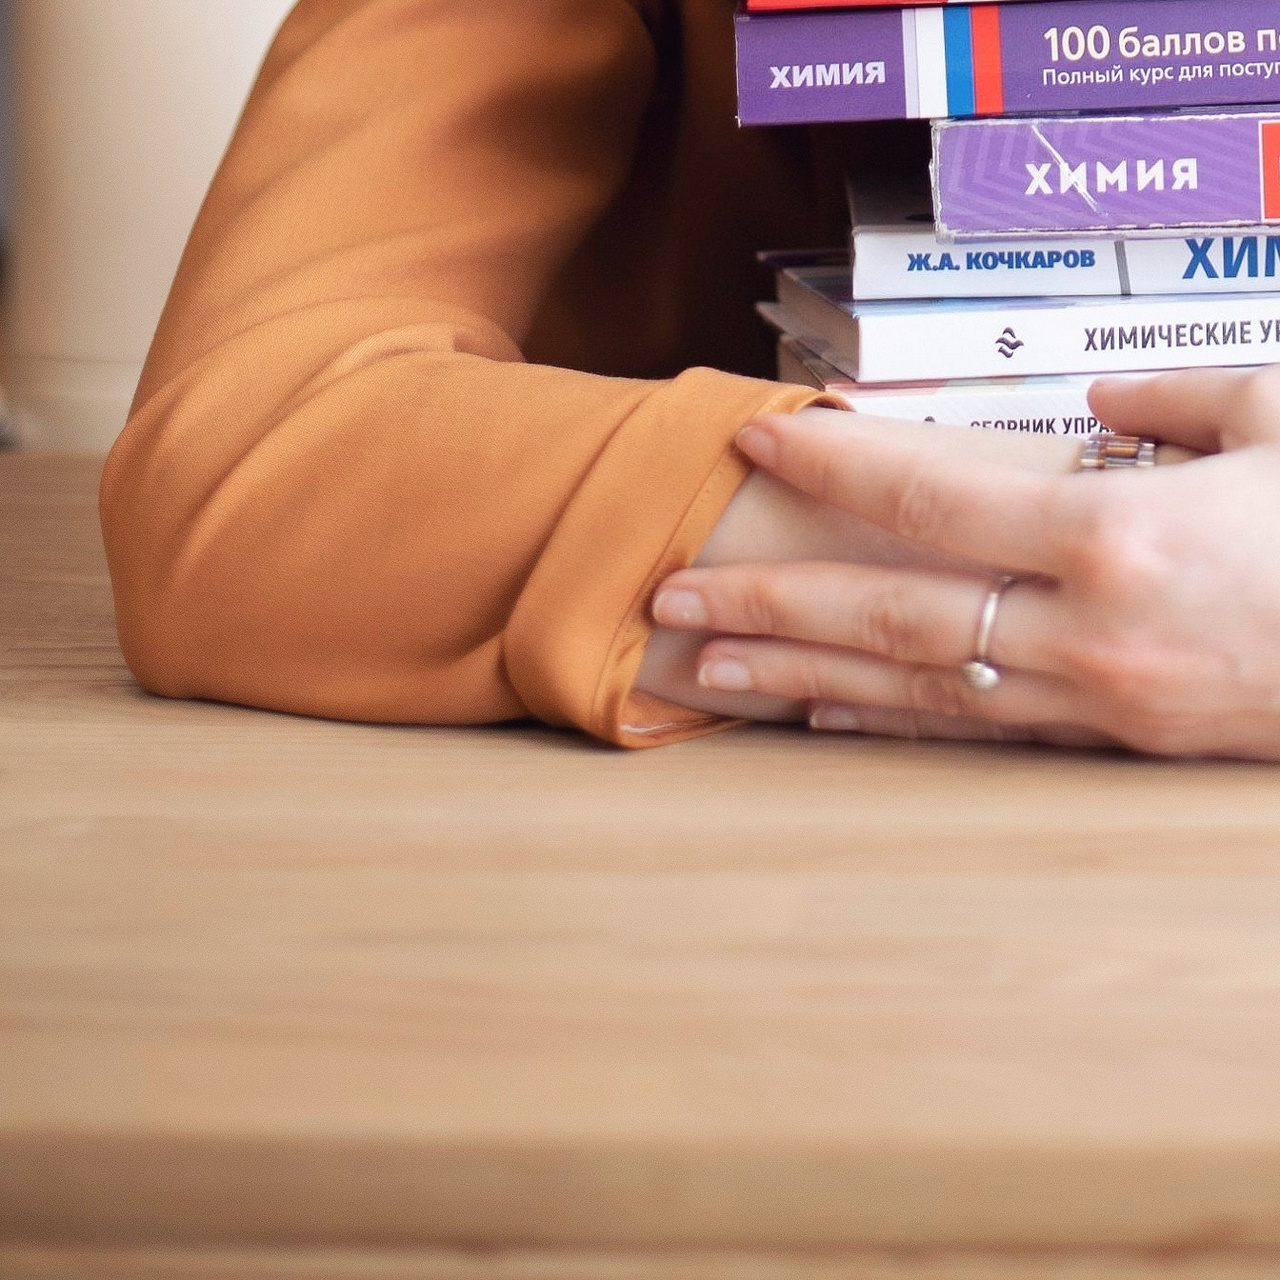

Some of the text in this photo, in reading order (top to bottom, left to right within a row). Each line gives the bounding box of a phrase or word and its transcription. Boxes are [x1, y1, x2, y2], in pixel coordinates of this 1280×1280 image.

[1043, 25, 1111, 62] 100
[1118, 26, 1246, 58] баллов
[1042, 65, 1124, 86] Полный
[1129, 66, 1174, 85] курс
[1178, 64, 1213, 82] для
[1024, 157, 1199, 196] ХИМИЯ
[906, 248, 1096, 272] Ж.А. КОЧКАРОВ
[1084, 320, 1251, 352] ХИМИЧЕСКИЕ
